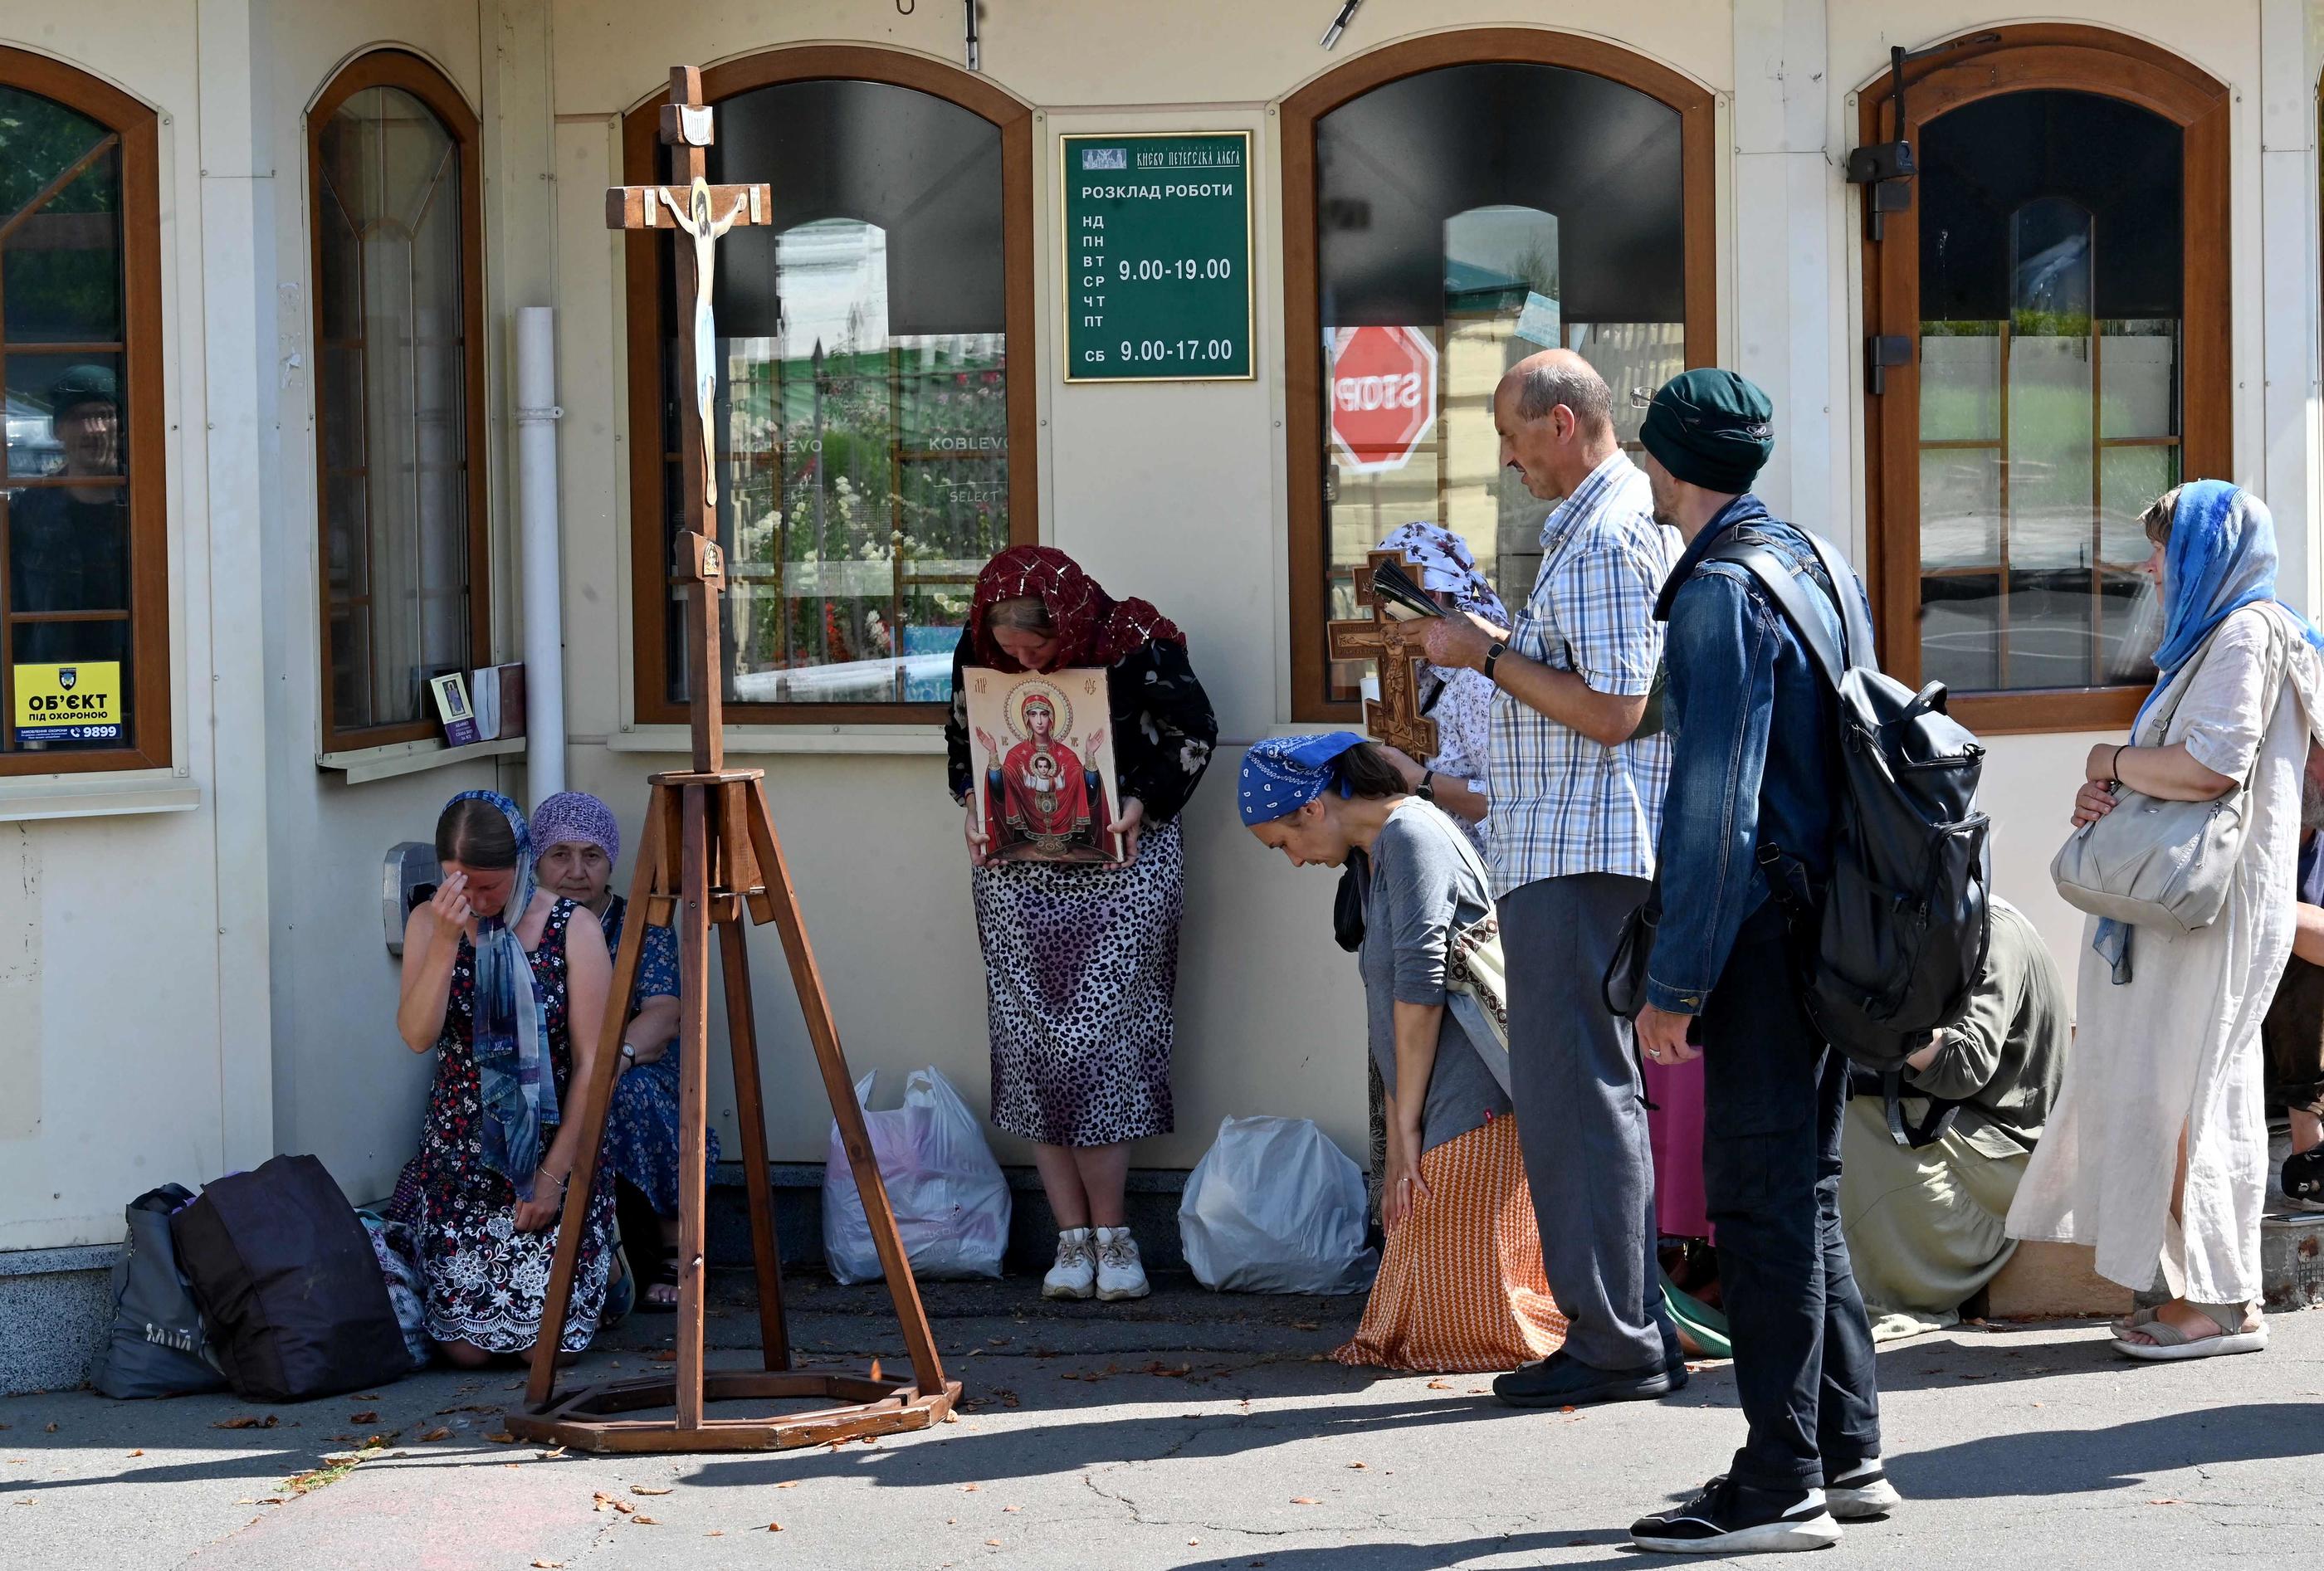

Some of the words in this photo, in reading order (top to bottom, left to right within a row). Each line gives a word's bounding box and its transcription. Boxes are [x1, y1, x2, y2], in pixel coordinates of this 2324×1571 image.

[1081, 185, 1161, 199] РОЗКЛАД
[1165, 183, 1233, 198] РОБОТИ
[1082, 216, 1105, 229] НД
[1083, 236, 1104, 247] ПН
[1119, 258, 1232, 281] 9.00-19.00
[1083, 276, 1105, 287] СР
[1083, 295, 1105, 307] ЧТ
[1084, 315, 1103, 327] ПТ
[1084, 350, 1106, 362] СБ
[1120, 339, 1233, 361] 9.00-17.00
[949, 490, 999, 503] SELECT
[49, 711, 108, 720] ОХОРОНОЮ
[83, 726, 117, 737] 9899
